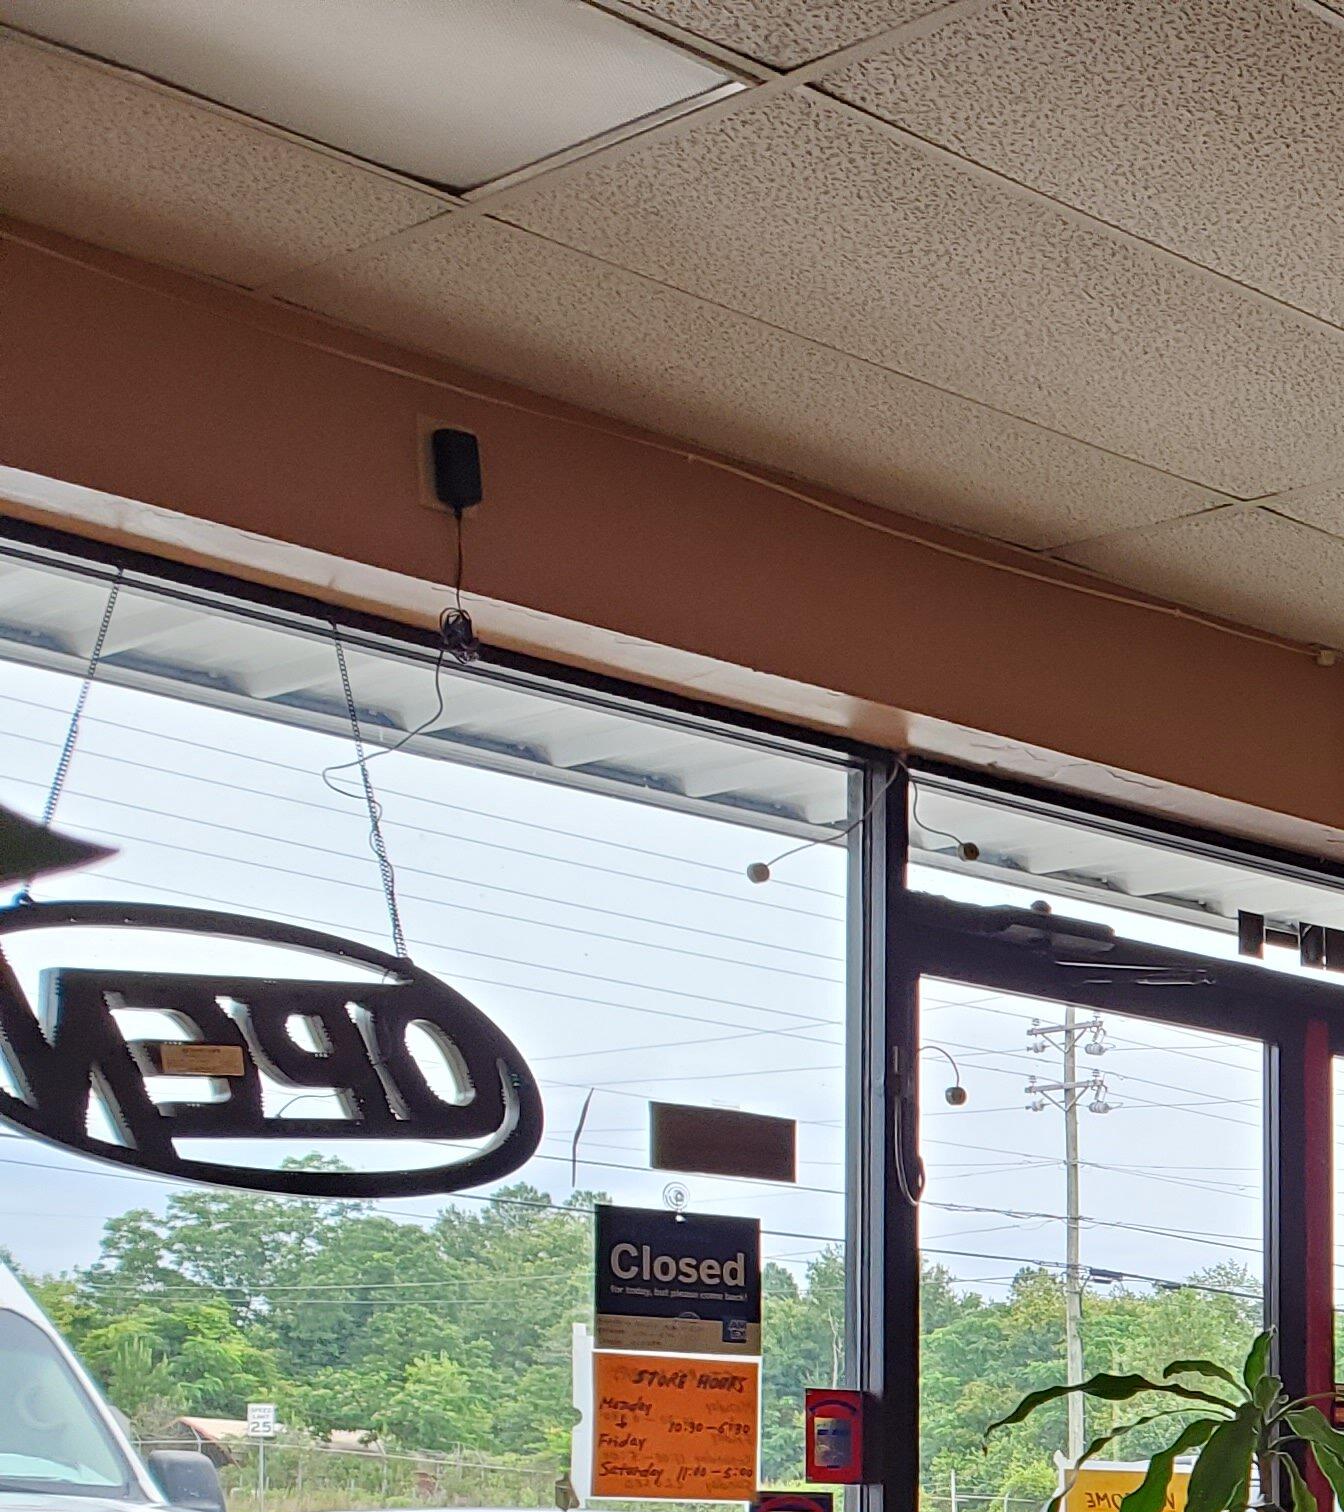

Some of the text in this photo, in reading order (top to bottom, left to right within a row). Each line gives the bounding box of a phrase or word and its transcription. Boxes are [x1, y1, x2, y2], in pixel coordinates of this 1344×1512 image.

[610, 1242, 746, 1287] Closed
[609, 1284, 624, 1294] for
[632, 1368, 748, 1393] STORE HOURS
[599, 1396, 653, 1416] Monday
[251, 1421, 272, 1433] 25
[598, 1433, 647, 1450] Friday
[598, 1461, 665, 1485] Saturday
